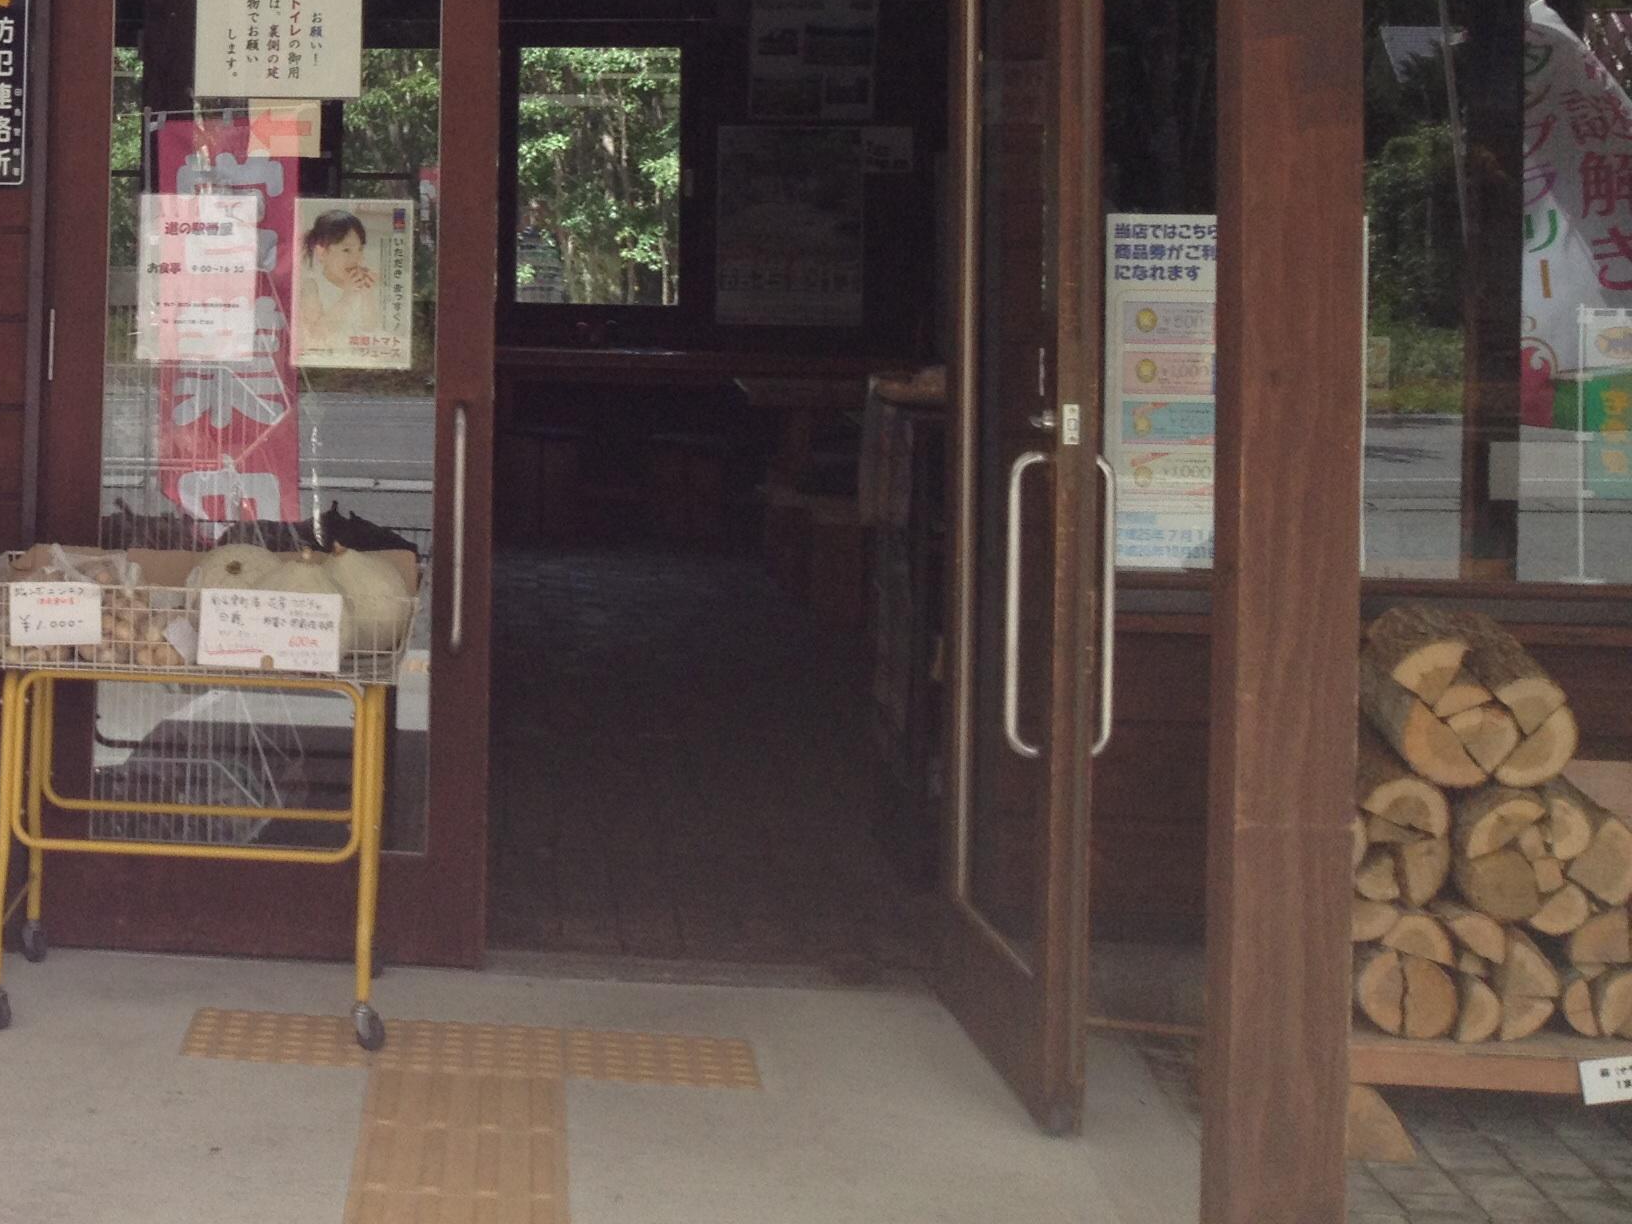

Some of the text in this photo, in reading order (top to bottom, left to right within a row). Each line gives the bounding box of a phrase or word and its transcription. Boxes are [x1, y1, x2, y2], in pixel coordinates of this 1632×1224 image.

[226, 28, 238, 77] します。
[164, 221, 234, 236] 道の駅番屋
[1114, 264, 1201, 281] になれます
